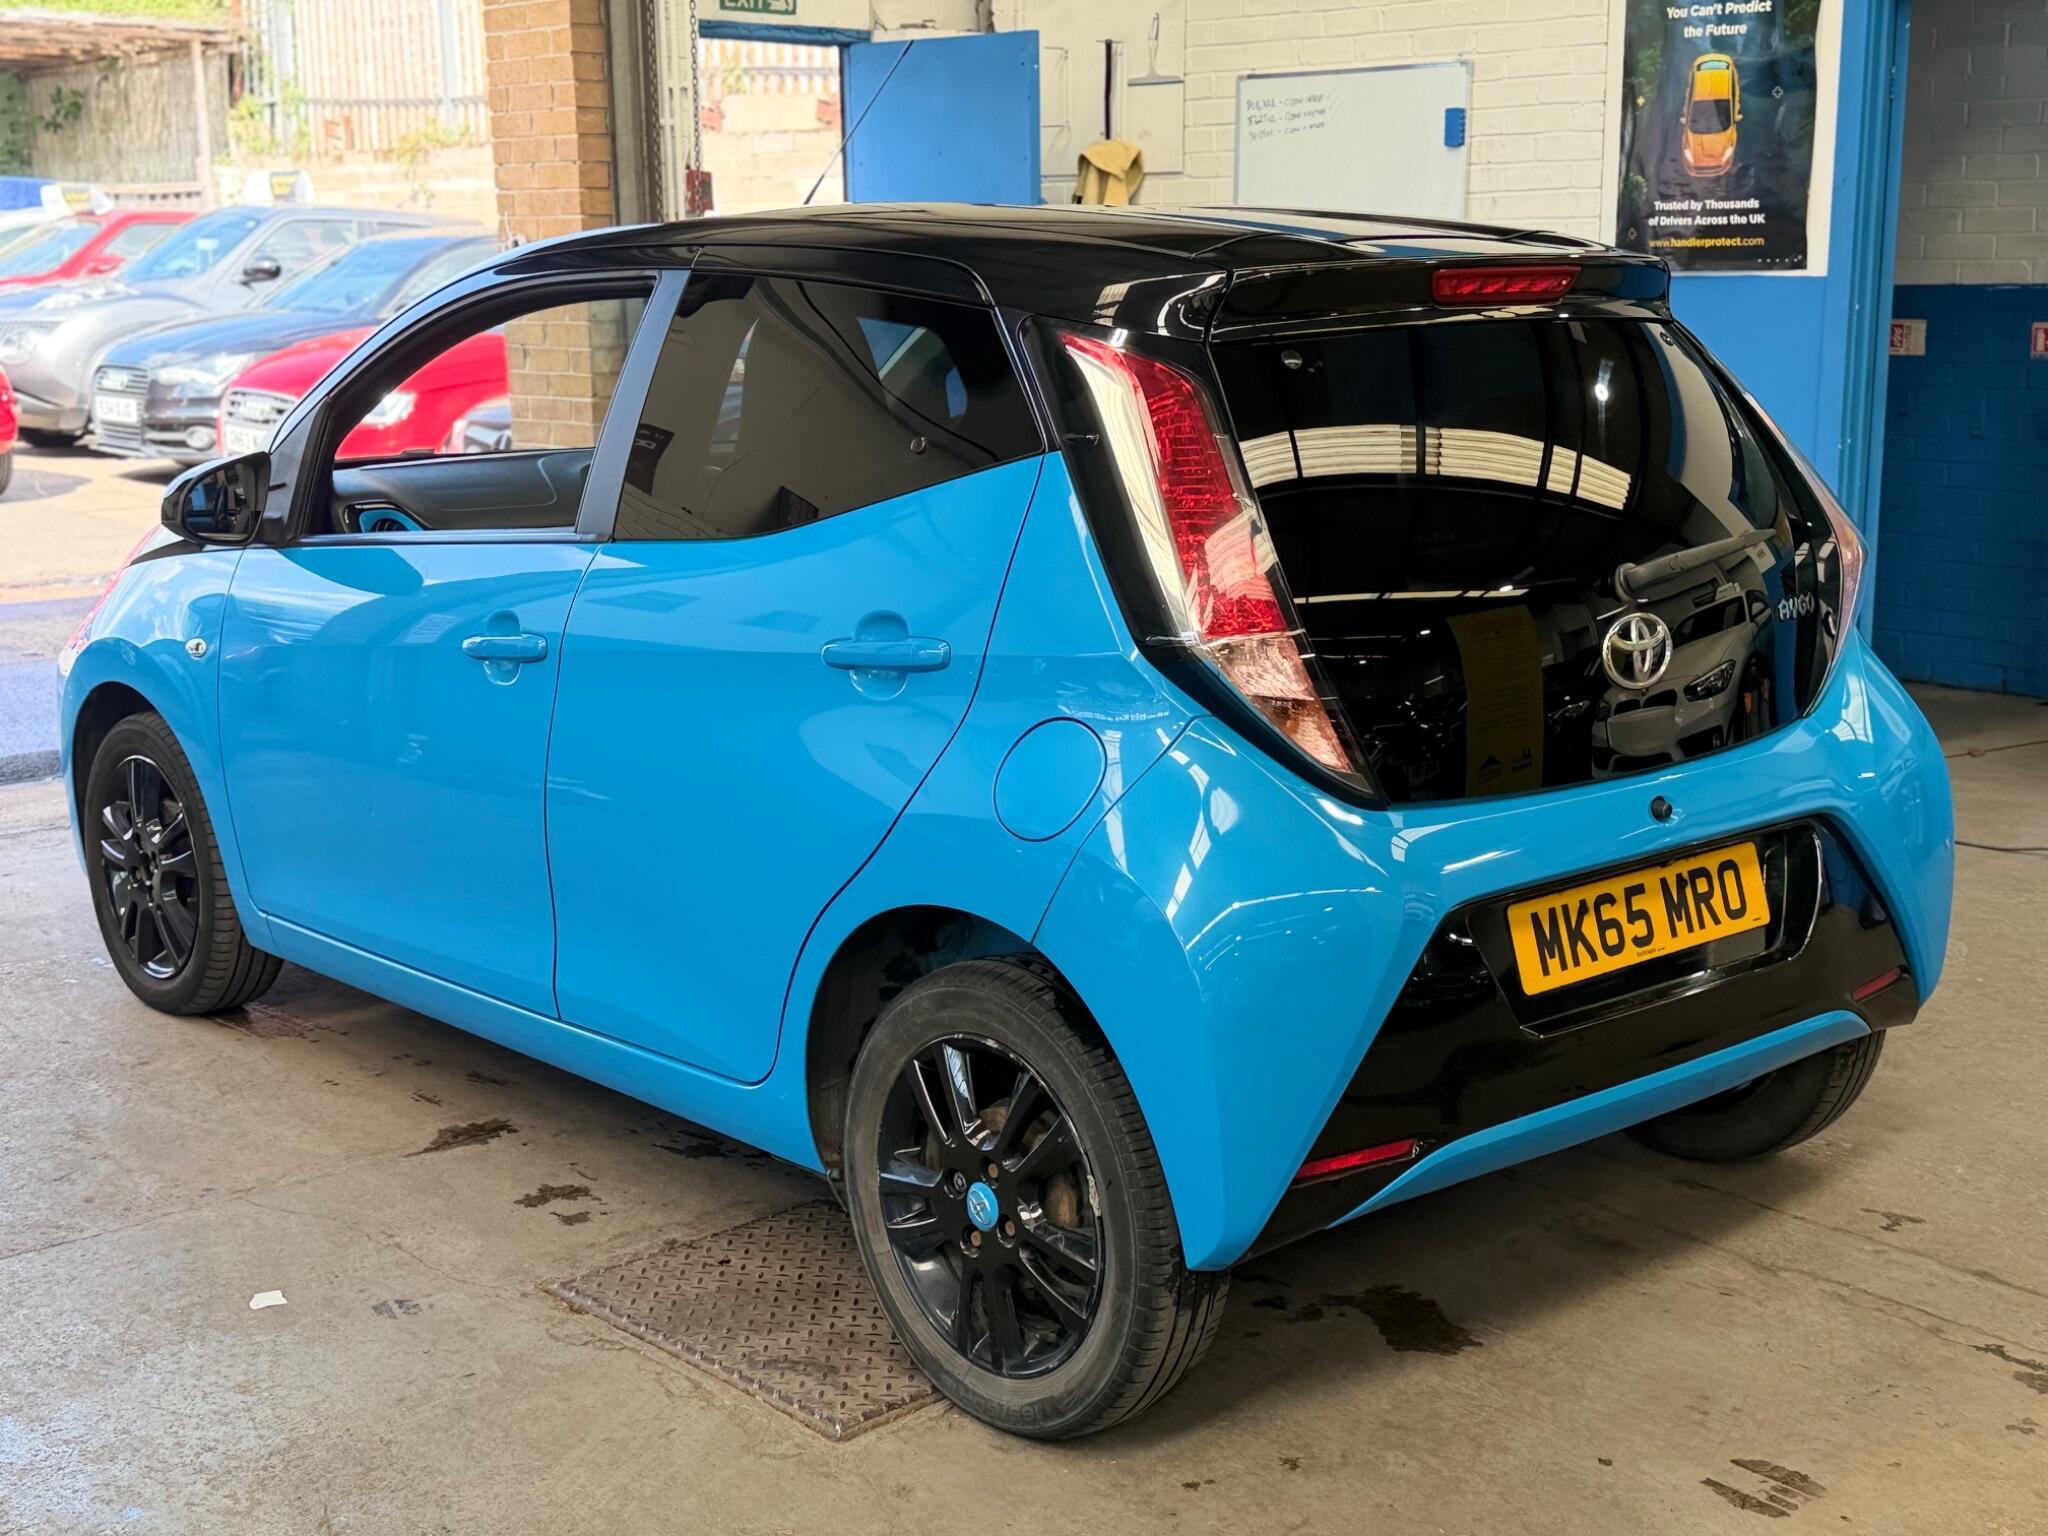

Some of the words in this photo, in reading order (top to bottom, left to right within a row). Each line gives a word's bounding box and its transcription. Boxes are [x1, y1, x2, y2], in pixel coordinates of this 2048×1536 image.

[1666, 7, 1688, 19] You
[1690, 3, 1723, 17] Can't
[1725, 0, 1772, 15] Predict
[1683, 25, 1703, 38] the
[1705, 23, 1748, 36] Future
[1654, 200, 1689, 211] Trusted
[1690, 200, 1703, 212] by
[1704, 198, 1760, 209] Thousands
[1648, 216, 1658, 226] of
[1660, 215, 1692, 226] Drivers
[1694, 215, 1728, 226] Across
[1729, 214, 1747, 225] the
[1749, 213, 1766, 224] UK
[1648, 236, 1765, 249] www.handlerprotect.com
[1778, 591, 1815, 620] AYGO
[1530, 883, 1655, 977] MK65
[1660, 858, 1748, 939] MRO
